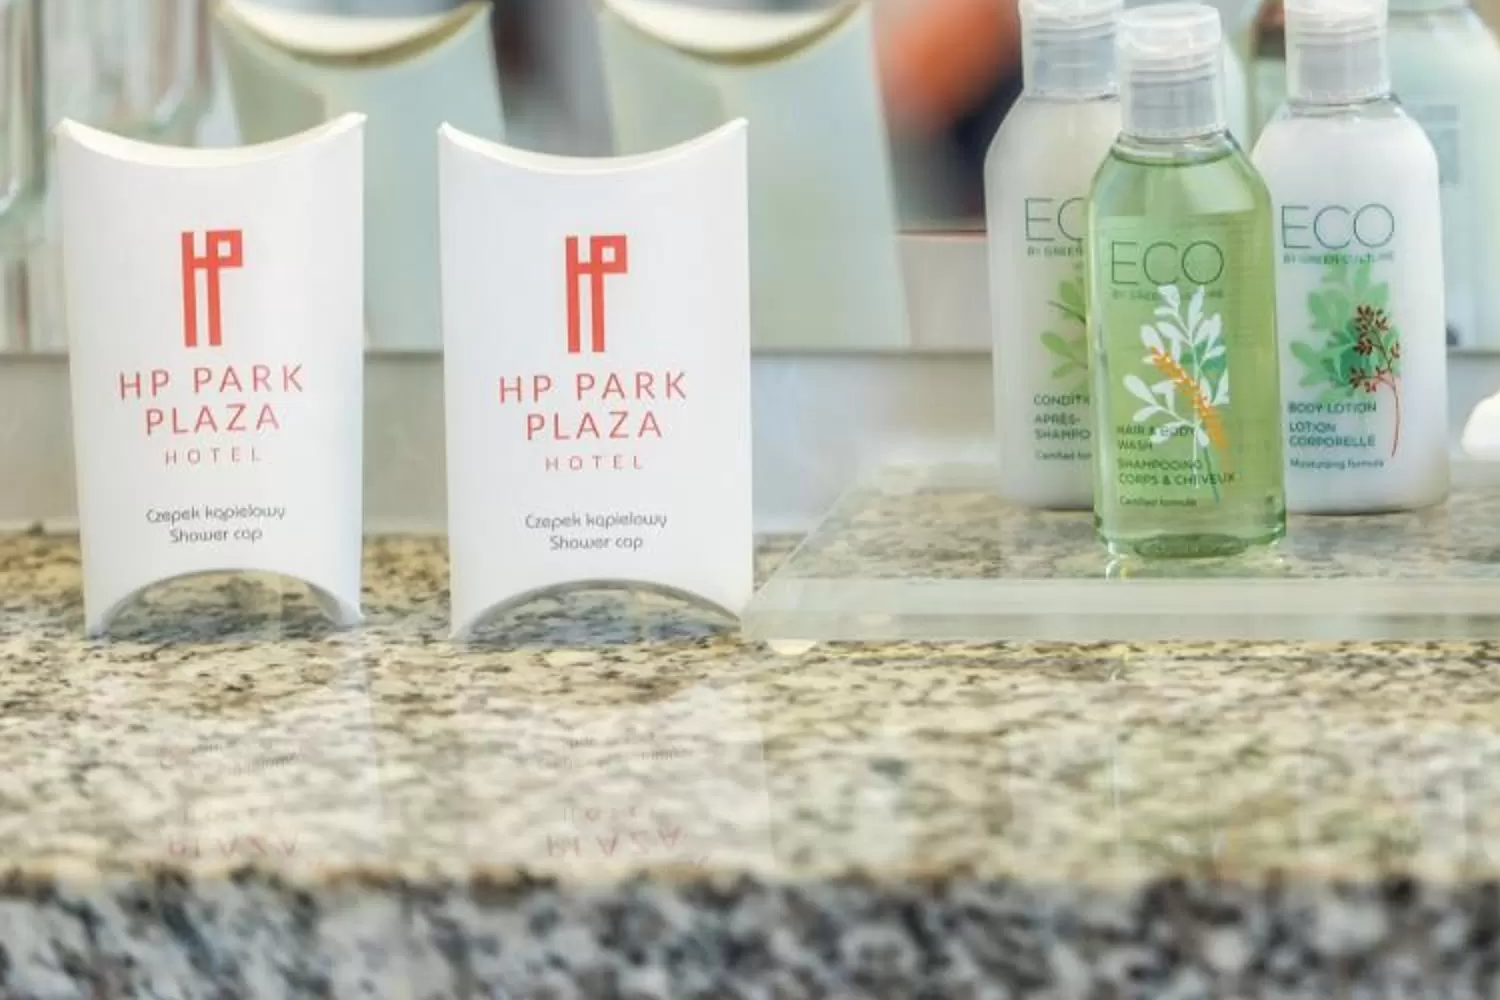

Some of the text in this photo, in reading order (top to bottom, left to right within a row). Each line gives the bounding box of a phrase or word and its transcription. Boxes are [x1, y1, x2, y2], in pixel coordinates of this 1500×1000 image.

[1023, 196, 1085, 242] EC
[1281, 203, 1395, 250] ECO
[1111, 239, 1225, 287] ECO
[118, 363, 304, 400] HP PARK
[498, 370, 688, 404] HP PARK
[1033, 392, 1091, 407] CONDITI
[1288, 401, 1377, 415] BODY LOTION
[145, 402, 281, 436] PLAZA
[526, 410, 663, 441] PLAZA
[1289, 421, 1337, 433] LOTION
[1033, 427, 1092, 441] SHAMPO
[1116, 424, 1145, 435] HAIR
[1117, 439, 1153, 451] WASH
[1289, 434, 1377, 447] CORPORELLE
[165, 446, 263, 465] HOTEL
[545, 454, 644, 471] HOTEL
[1117, 458, 1203, 471] SHAMPOOING
[1119, 472, 1235, 486] CORPS & CHVEUX
[145, 505, 201, 525] Czepek
[524, 512, 582, 531] Czepek
[169, 527, 263, 544] Shower cap
[549, 534, 644, 551] Shower cap
